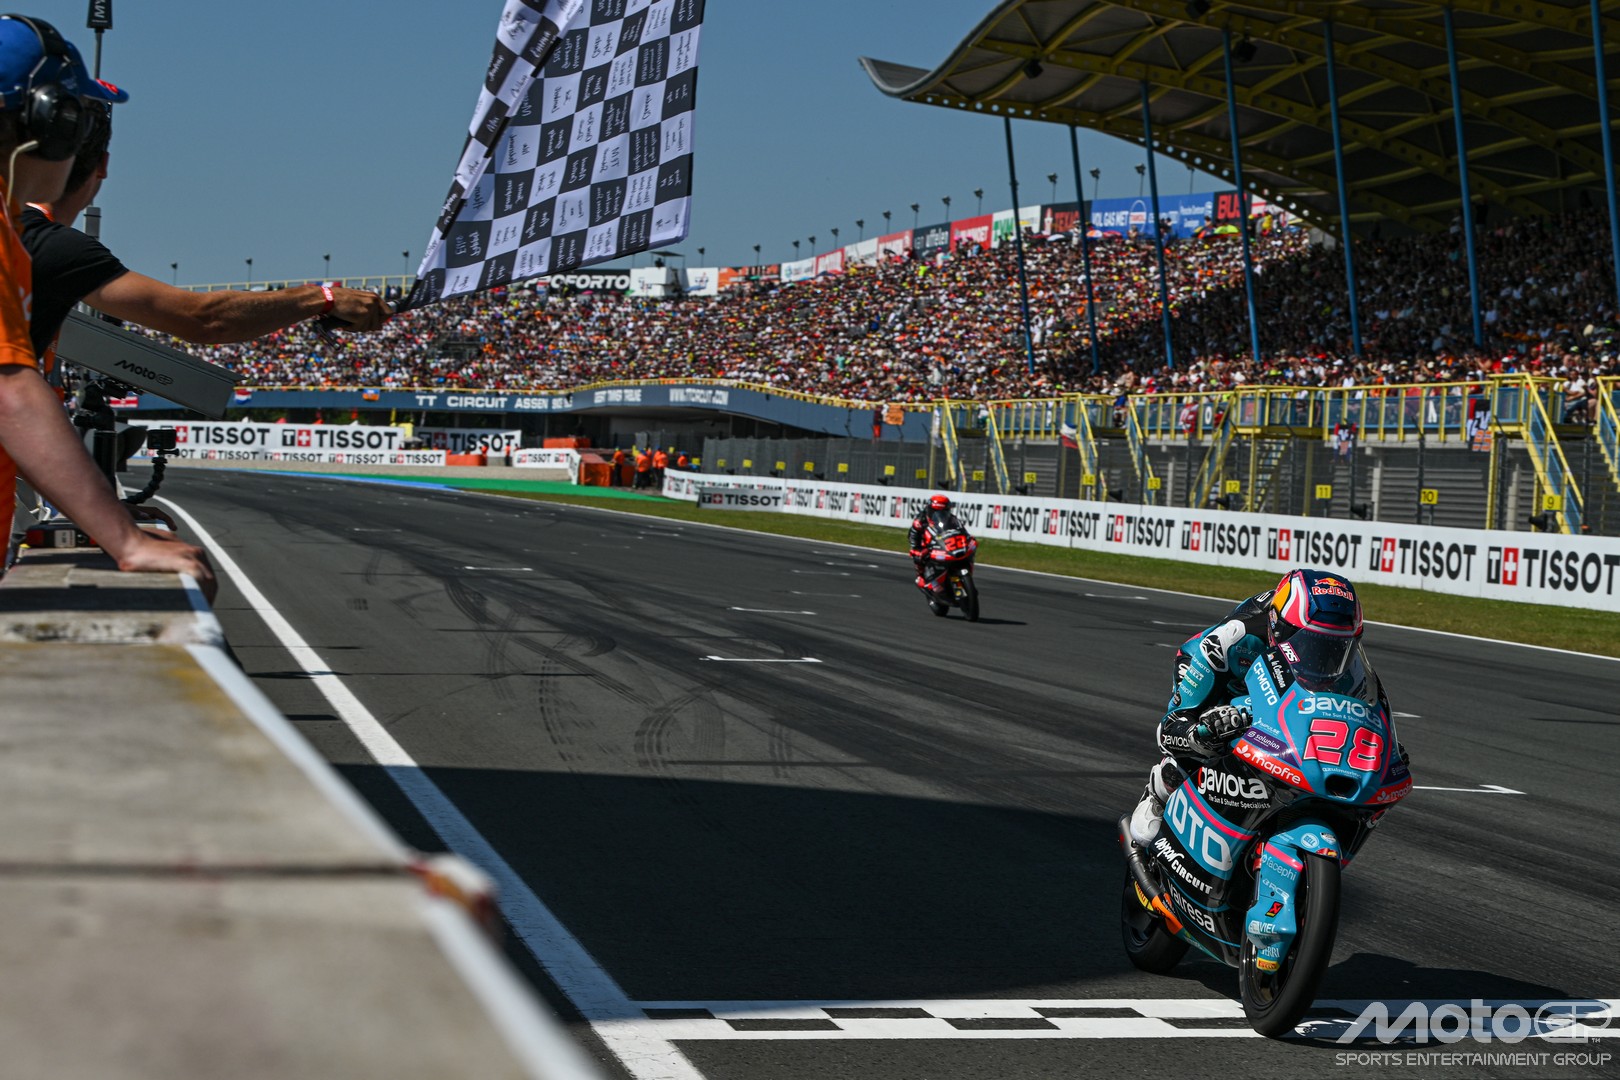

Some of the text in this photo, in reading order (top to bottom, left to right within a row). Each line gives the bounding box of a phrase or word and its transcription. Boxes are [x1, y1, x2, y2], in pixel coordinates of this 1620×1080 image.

[416, 394, 437, 407] TT
[446, 395, 508, 409] CIRCUIT
[191, 426, 270, 446] TISSOT
[315, 430, 398, 450] TISSOT
[449, 432, 515, 452] TISSOT
[218, 450, 259, 461] TISSOT
[282, 452, 323, 462] TISSOT
[346, 453, 384, 464] TISSOT
[405, 453, 443, 464] TISSOT
[1085, 475, 1094, 484] 14
[1149, 479, 1159, 488] 13
[1228, 482, 1239, 492] 12
[725, 494, 782, 506] TISSOT
[1319, 487, 1329, 497] 11
[1422, 491, 1434, 502] 10
[903, 497, 929, 520] TISS
[1547, 496, 1555, 509] 9
[1002, 506, 1039, 532] TISSOT
[1059, 510, 1100, 540] TISSOT
[1126, 516, 1175, 548] TISSOT
[1203, 522, 1261, 557] TISSOT
[1293, 530, 1362, 568] TISSOT
[1398, 539, 1477, 581] TISSOT
[1522, 548, 1620, 595] TISSOT
[1311, 586, 1354, 601] Red Bull
[1280, 642, 1298, 663] WRS
[1252, 661, 1278, 706] CFMOTO
[1297, 696, 1383, 730] gaviota
[1255, 734, 1280, 750] solunion
[1303, 718, 1385, 773] 28
[1251, 752, 1301, 785] mapfre
[1197, 766, 1269, 800] gaviota
[1224, 799, 1240, 808] Shutter
[1240, 801, 1271, 809] Specialists
[1171, 858, 1213, 895] CIRCUIT
[1266, 856, 1297, 881] facephi
